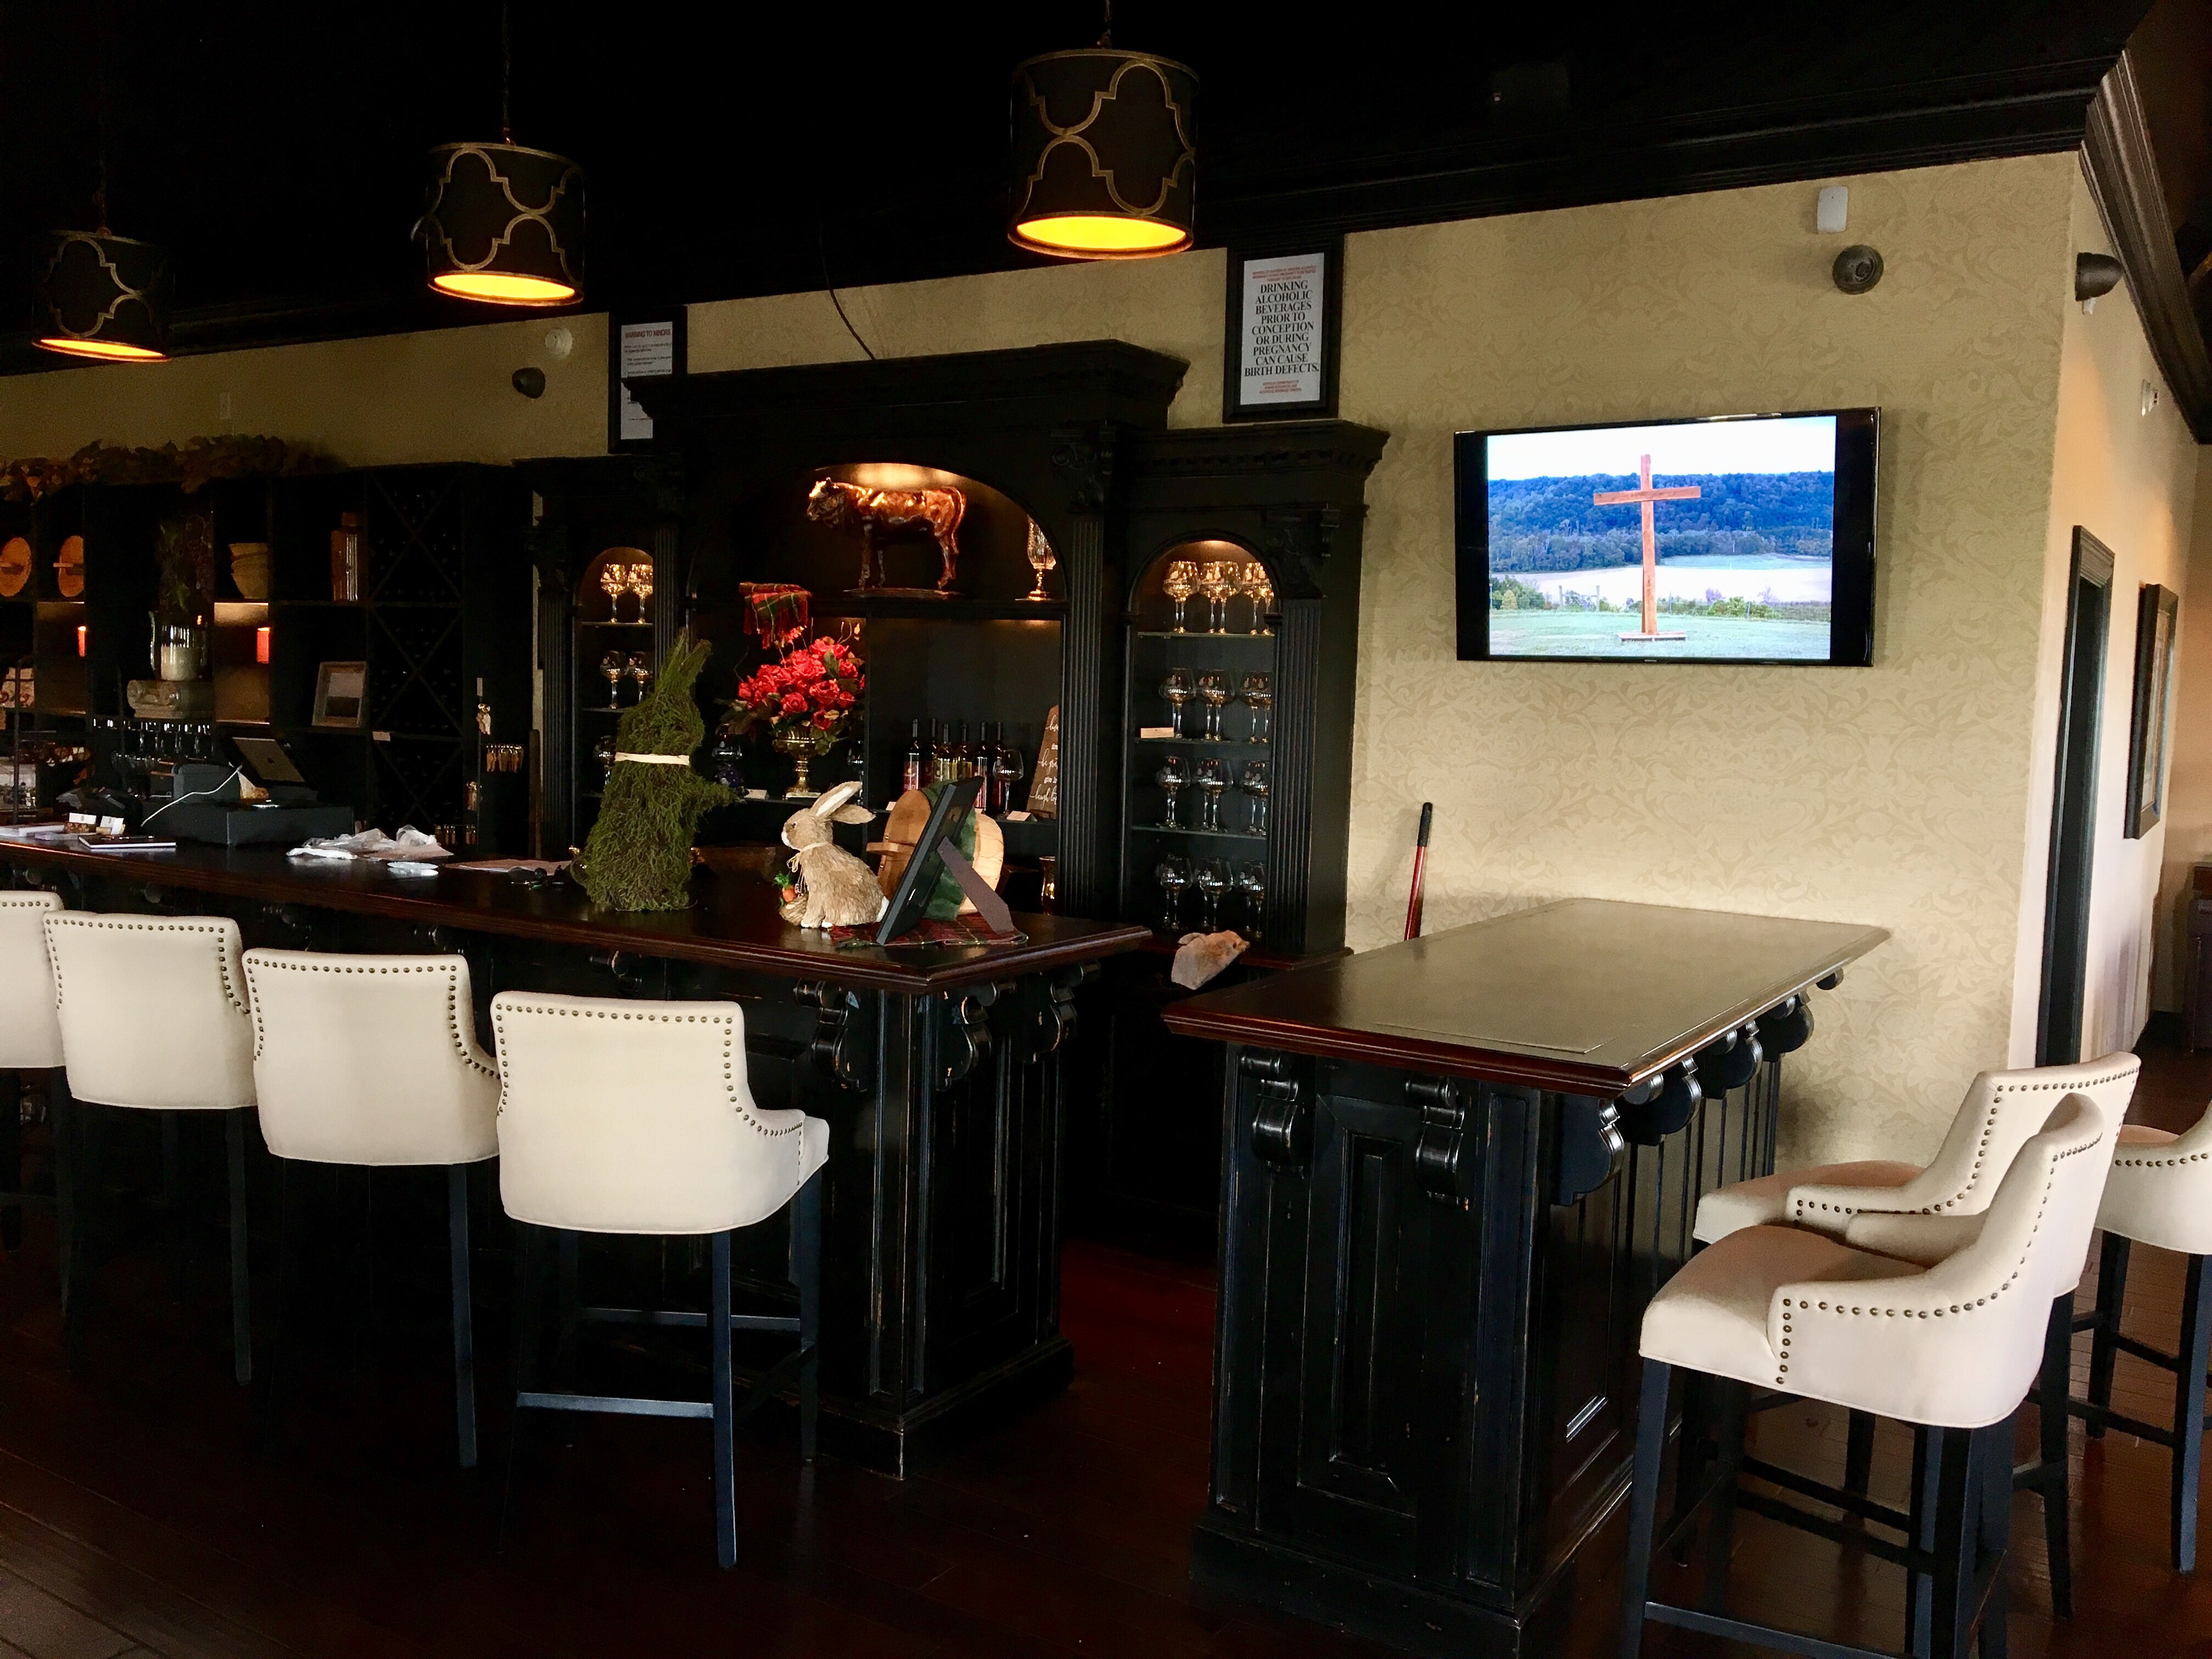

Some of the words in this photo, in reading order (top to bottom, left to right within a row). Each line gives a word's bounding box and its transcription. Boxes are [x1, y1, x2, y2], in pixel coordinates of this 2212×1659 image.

[1261, 280, 1308, 293] DRINKING
[1255, 290, 1313, 304] ALCOHOLIC
[1256, 301, 1312, 314] BEVERAGES
[1262, 313, 1290, 324] PRIOR
[1293, 312, 1306, 321] TO
[1252, 321, 1314, 335] CONCEPTION
[1256, 336, 1269, 345] OR
[1273, 332, 1309, 343] DURING
[1254, 342, 1312, 356] PREGNANCY
[1256, 356, 1275, 365] CAN
[1277, 353, 1308, 364] CAUSE
[1244, 366, 1272, 376] BIRTH
[1275, 363, 1319, 374] DEFECTS.
